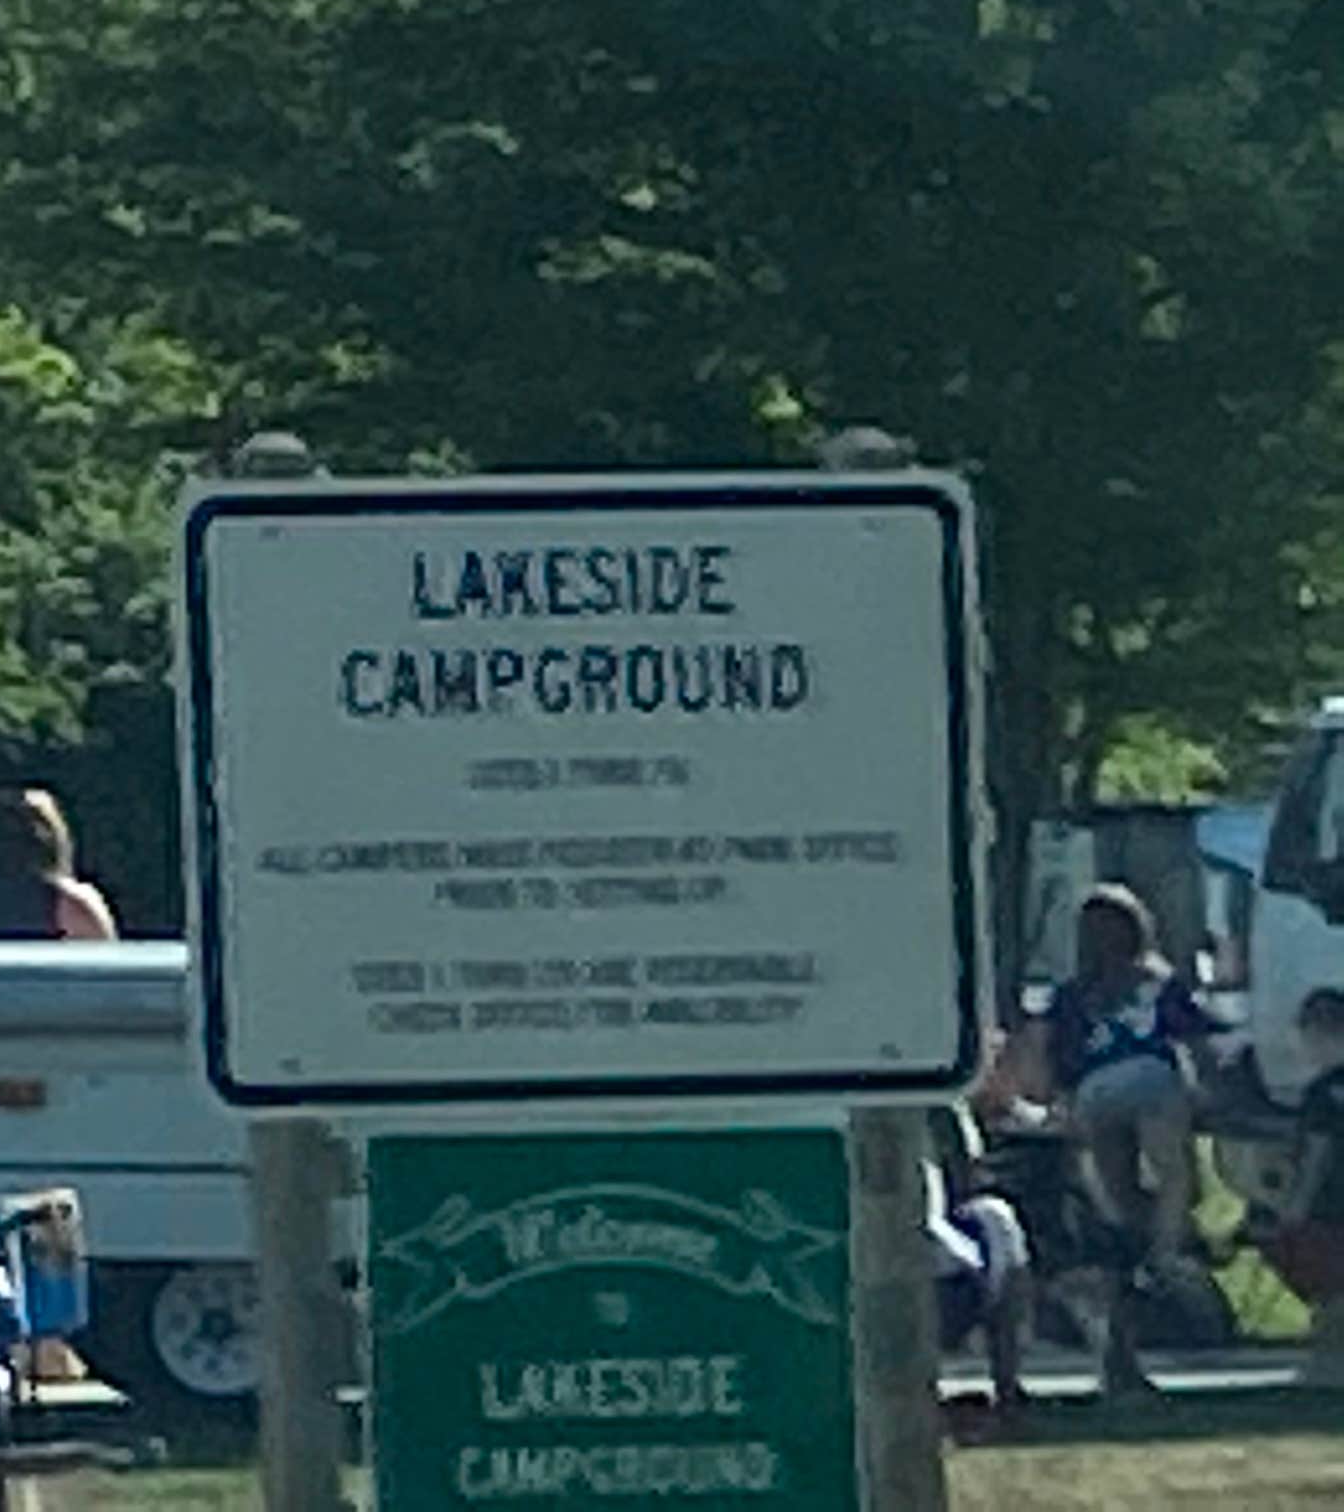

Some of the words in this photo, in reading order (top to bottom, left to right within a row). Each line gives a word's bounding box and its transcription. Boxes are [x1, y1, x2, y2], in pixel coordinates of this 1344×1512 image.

[411, 544, 737, 619] LAKESIDE
[342, 644, 812, 718] CAMPGROUND
[478, 1355, 745, 1419] LAKESIDE
